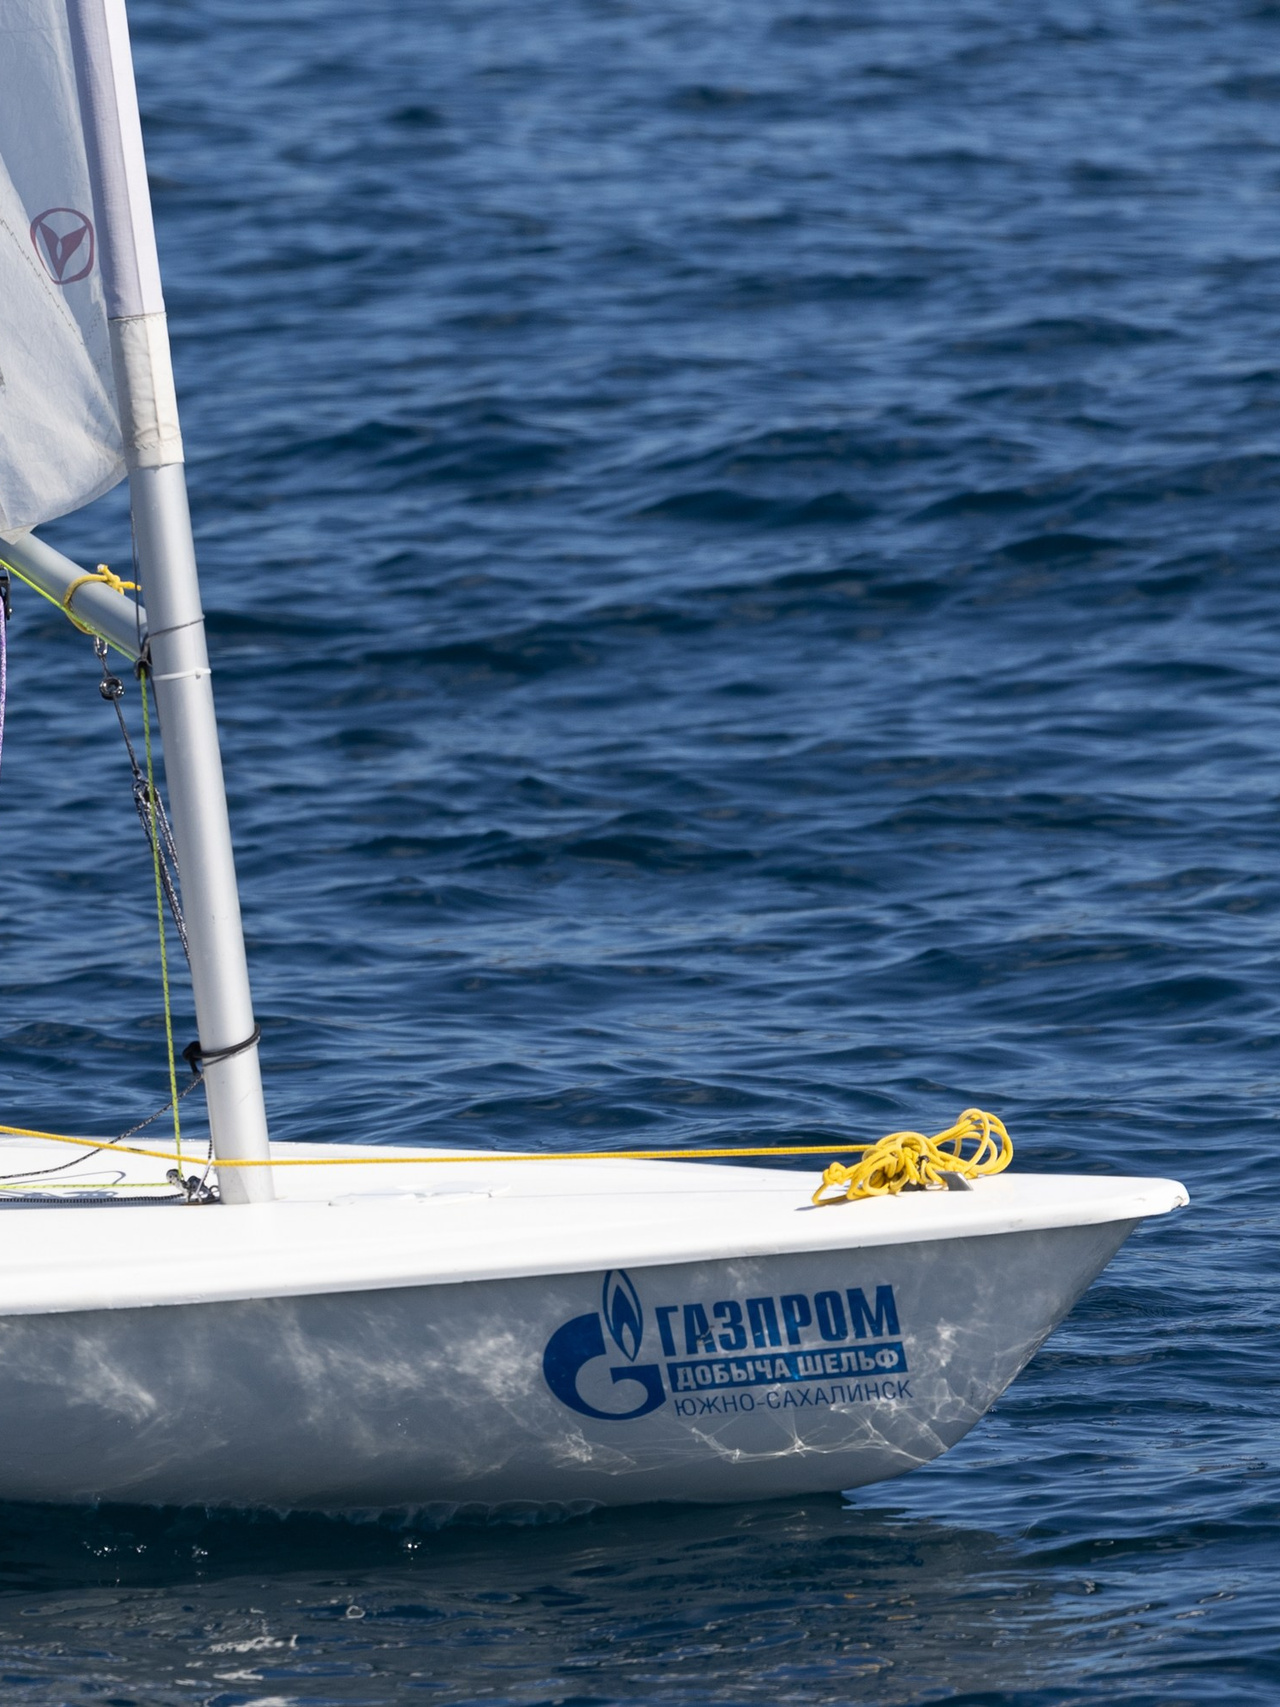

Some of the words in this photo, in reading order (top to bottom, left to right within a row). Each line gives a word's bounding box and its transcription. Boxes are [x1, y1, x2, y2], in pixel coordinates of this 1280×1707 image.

[655, 1284, 901, 1357] ГАЗПРОМ
[677, 1355, 790, 1390] ДОБЫЧА
[798, 1348, 900, 1375] ШЕЛЬФ
[674, 1380, 913, 1416] ЮЖНО-САХАЛИНСК
